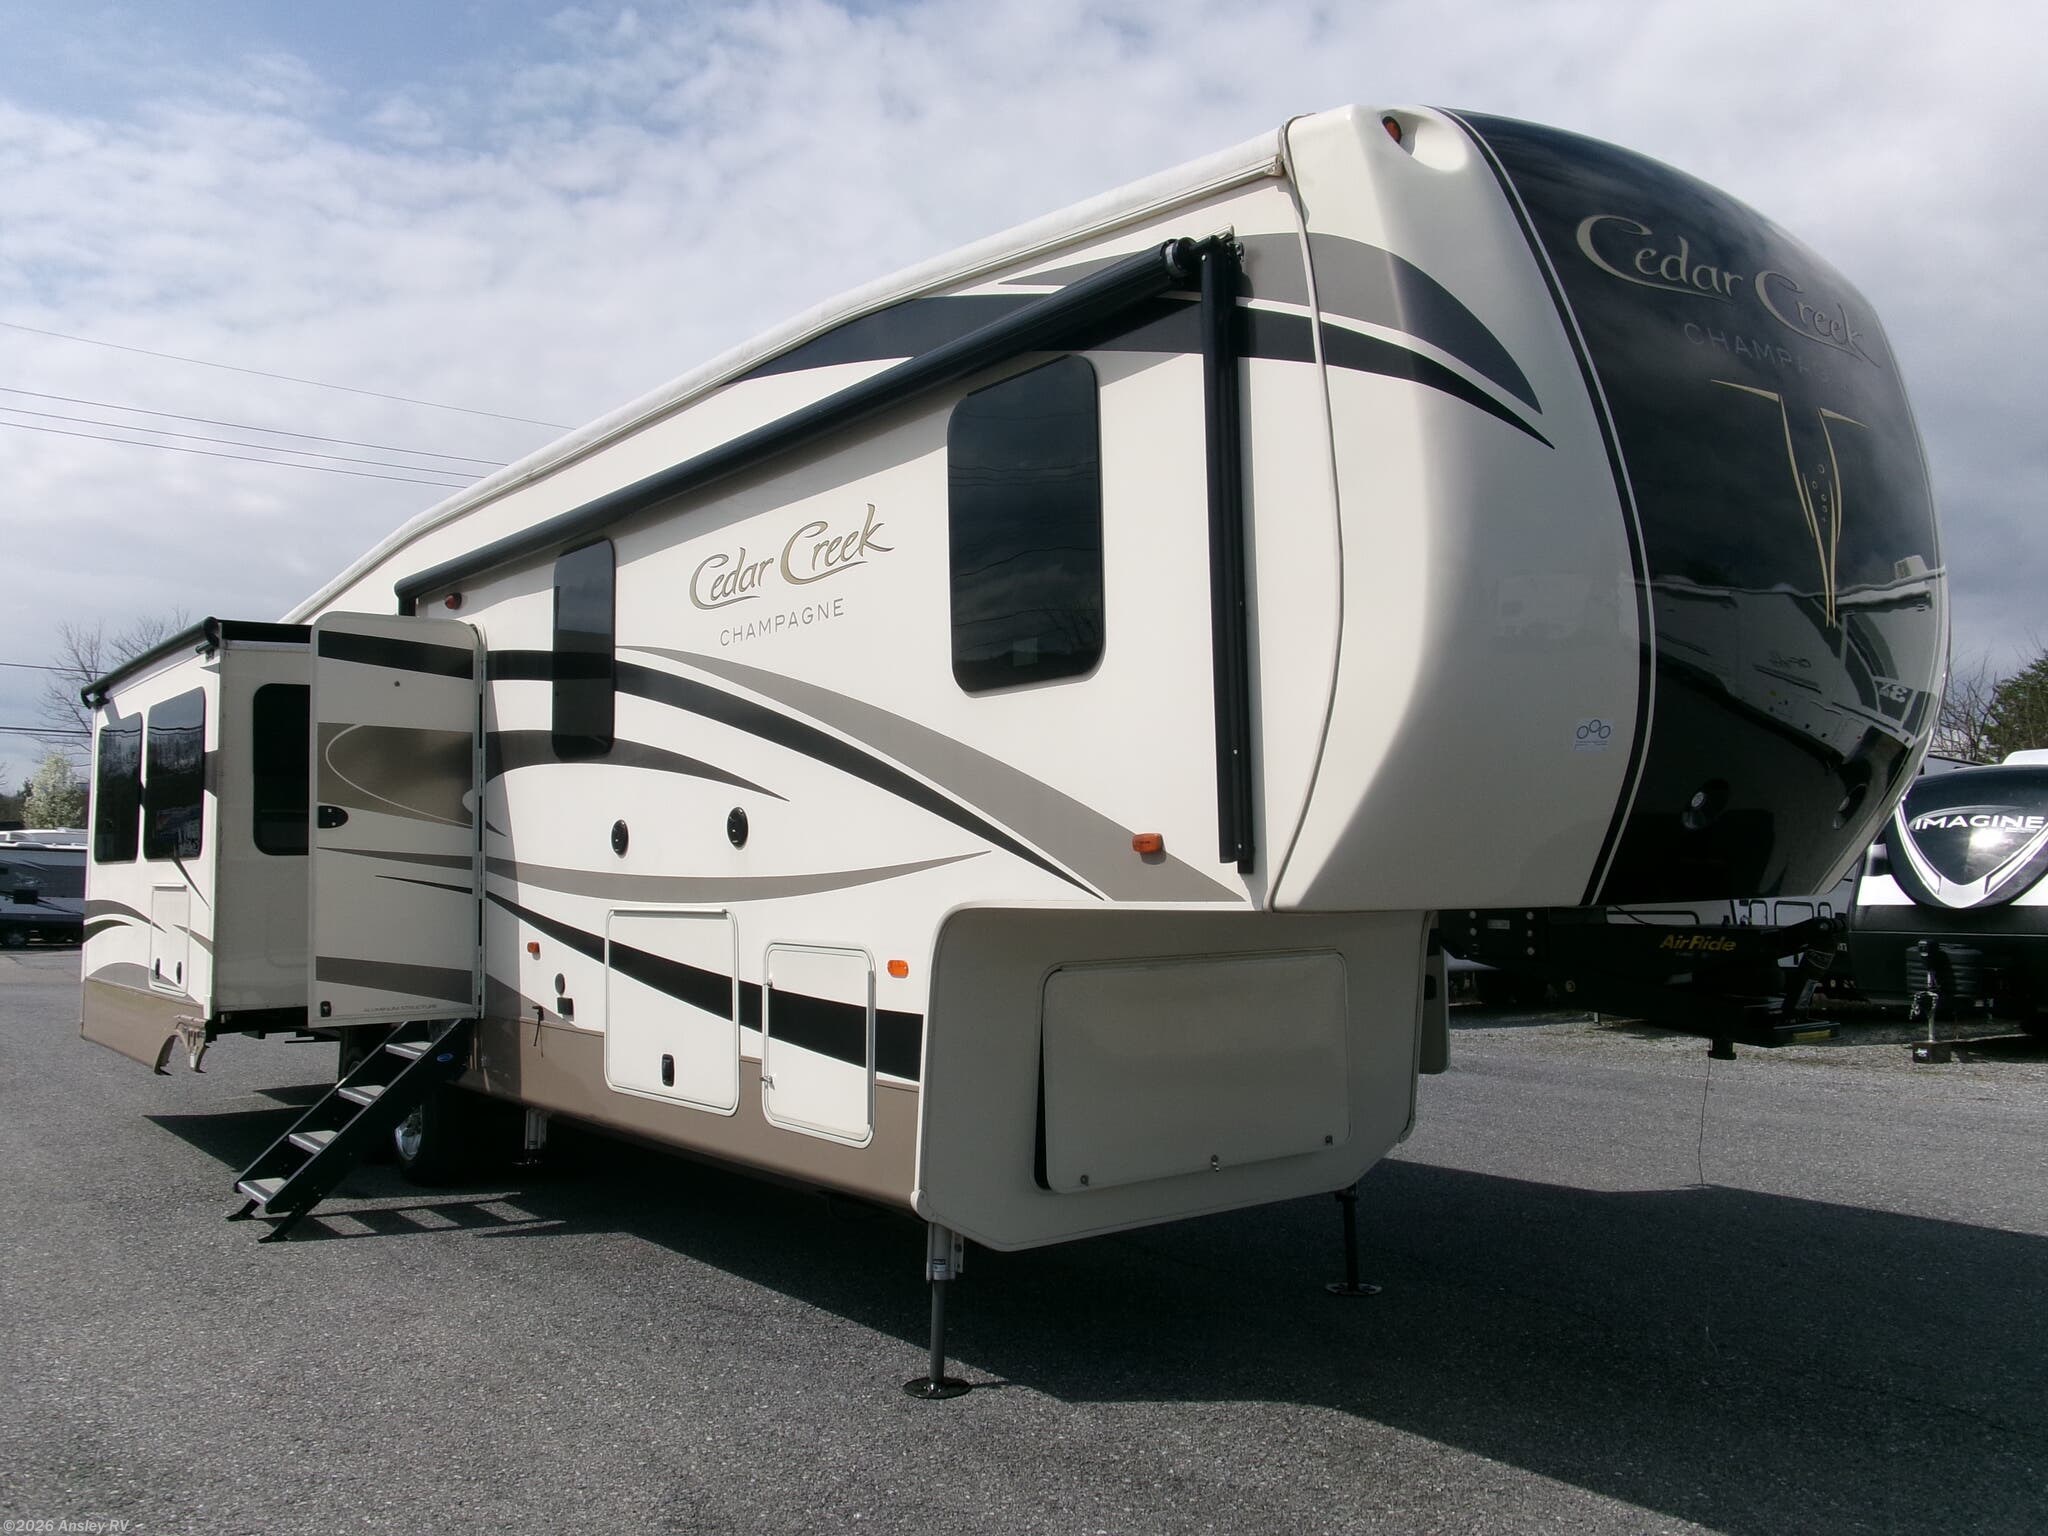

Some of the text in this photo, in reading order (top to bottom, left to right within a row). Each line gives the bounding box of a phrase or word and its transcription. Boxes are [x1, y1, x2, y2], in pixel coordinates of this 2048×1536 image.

[1577, 215, 1881, 368] Cedar Creek
[689, 503, 895, 610] Cedar Creek
[720, 598, 844, 647] CHAMPAGNE
[1915, 815, 2045, 830] IMAGINE
